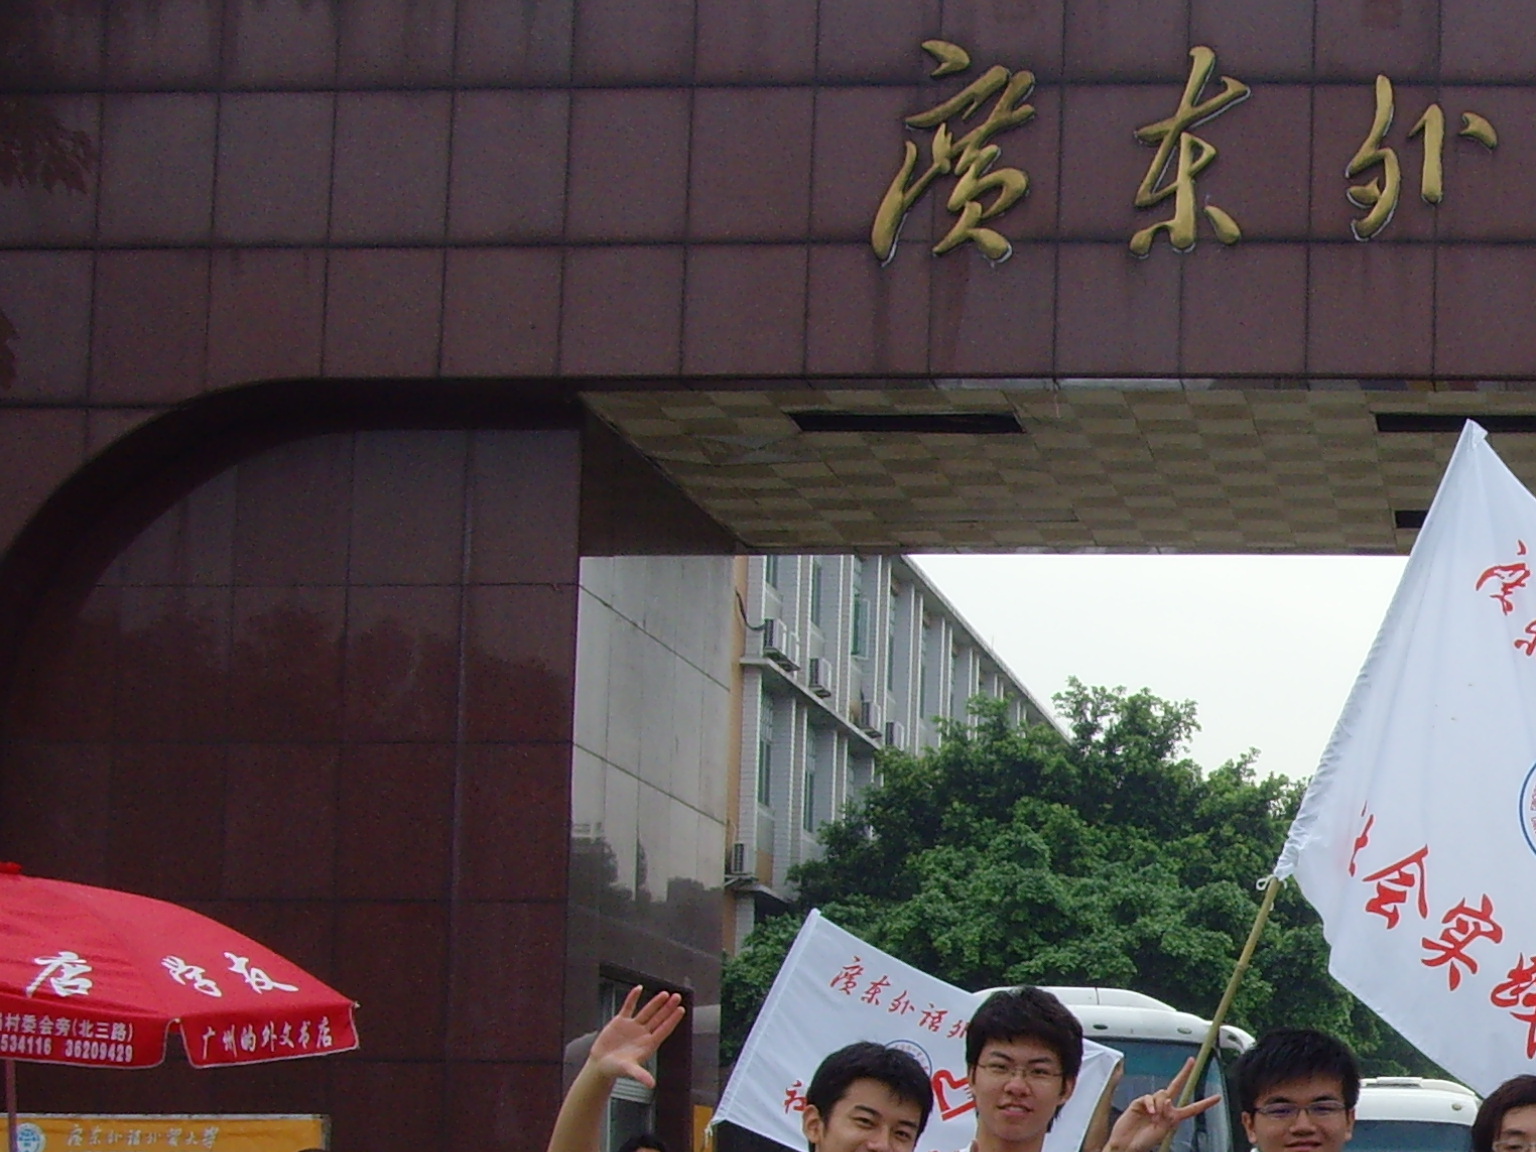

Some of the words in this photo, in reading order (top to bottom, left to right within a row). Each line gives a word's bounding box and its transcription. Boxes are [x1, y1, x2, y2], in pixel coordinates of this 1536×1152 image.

[0, 1012, 133, 1042] 村委会旁(北三路)
[202, 1017, 333, 1060] 广州的外文书店
[65, 1039, 133, 1063] 36209429
